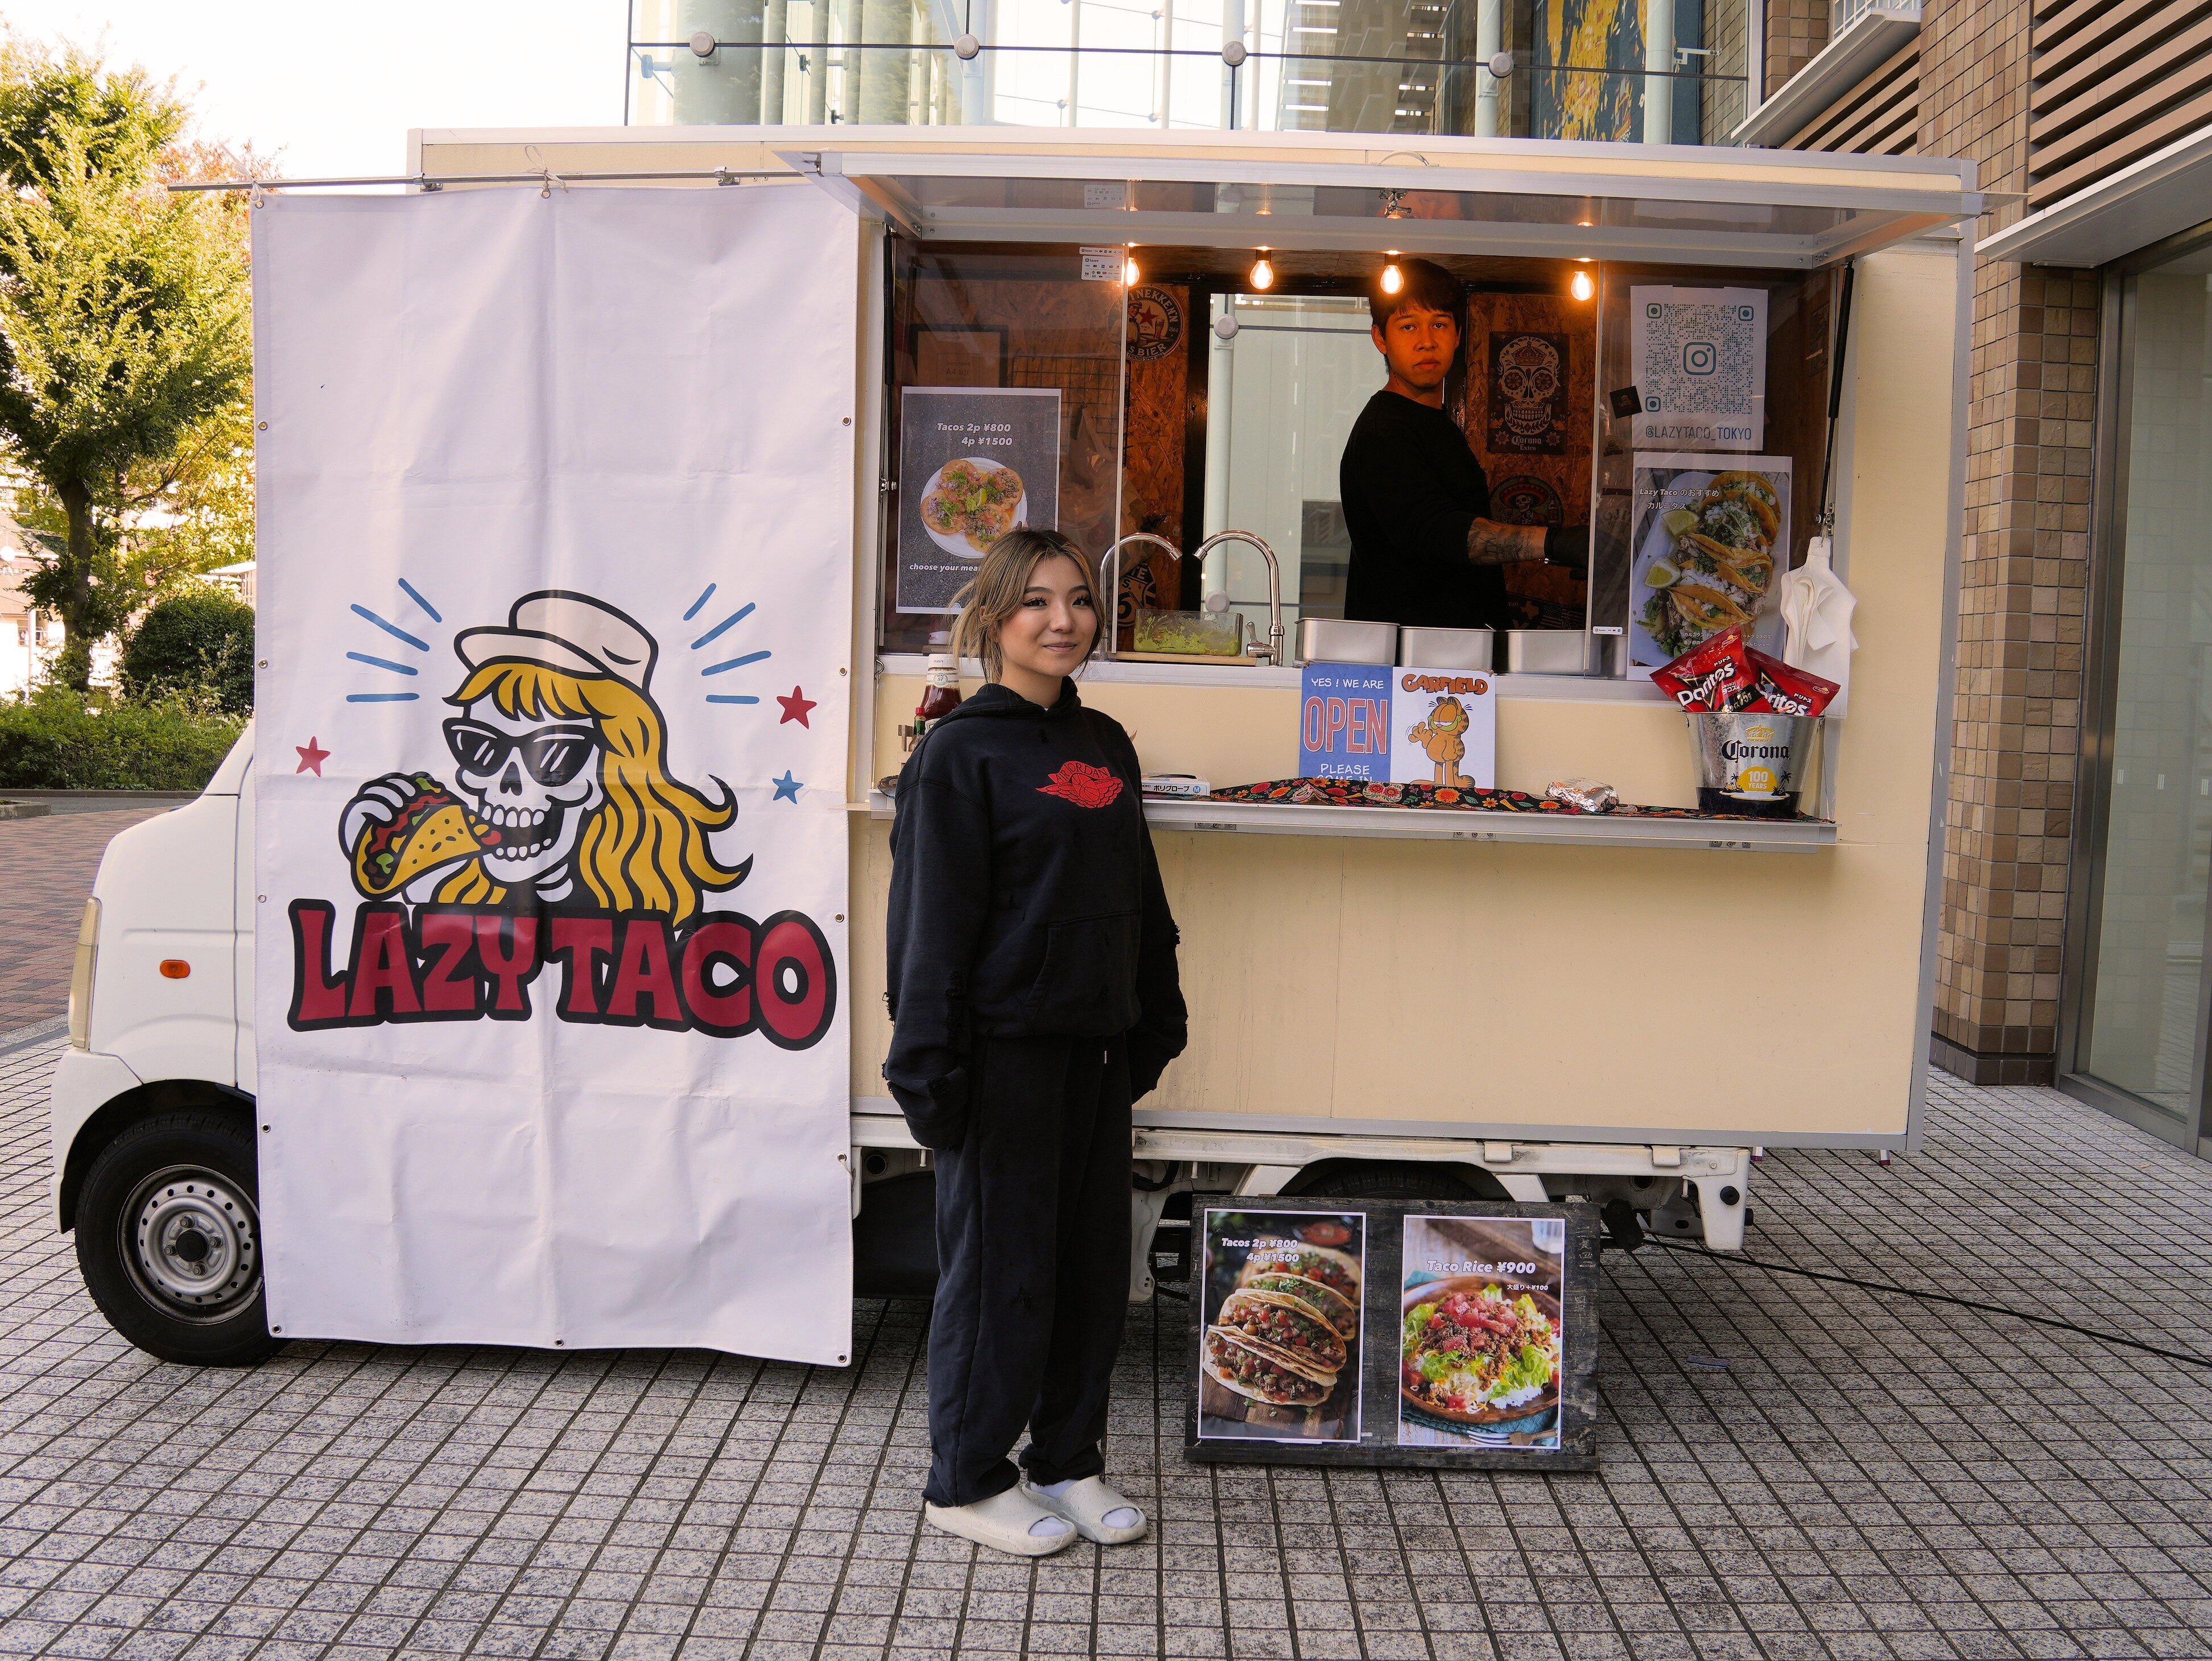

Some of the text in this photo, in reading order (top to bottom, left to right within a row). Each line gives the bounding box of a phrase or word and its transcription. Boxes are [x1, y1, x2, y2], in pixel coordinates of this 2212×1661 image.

[1138, 342, 1167, 356] BIER
[936, 423, 1012, 433] Tacos 2p ¥800
[1646, 425, 1752, 441] @LAZYTACO_TOKYO
[960, 436, 1013, 447] 4p ¥1500
[1511, 435, 1542, 447] Corona
[1639, 488, 1658, 497] Lazy
[1680, 489, 1719, 497] のおすすめ
[1648, 501, 1686, 510] カルニタス
[909, 563, 938, 571] choose
[939, 564, 960, 573] your
[1714, 655, 1731, 667] ドリトス
[1311, 677, 1332, 688] YES
[1342, 679, 1359, 689] WE
[1362, 680, 1384, 689] ARE
[1401, 673, 1489, 696] GARFIELD
[1677, 662, 1735, 706] Doritos
[1759, 689, 1809, 717] ritos
[1793, 692, 1812, 704] ドリトス
[1303, 695, 1388, 755] OPEN
[1721, 739, 1791, 763] Corona
[1055, 763, 1109, 783] AIR JORDAN
[1320, 763, 1371, 775] PLEASE
[1747, 770, 1769, 783] 100
[1153, 784, 1190, 793] ポリグローブ
[287, 898, 837, 1052] LAZY TACO
[1221, 1237, 1299, 1250] Tacos 2p ¥800
[1246, 1252, 1300, 1263] 4p ¥1500
[1427, 1259, 1536, 1274] Taco Rice ¥900
